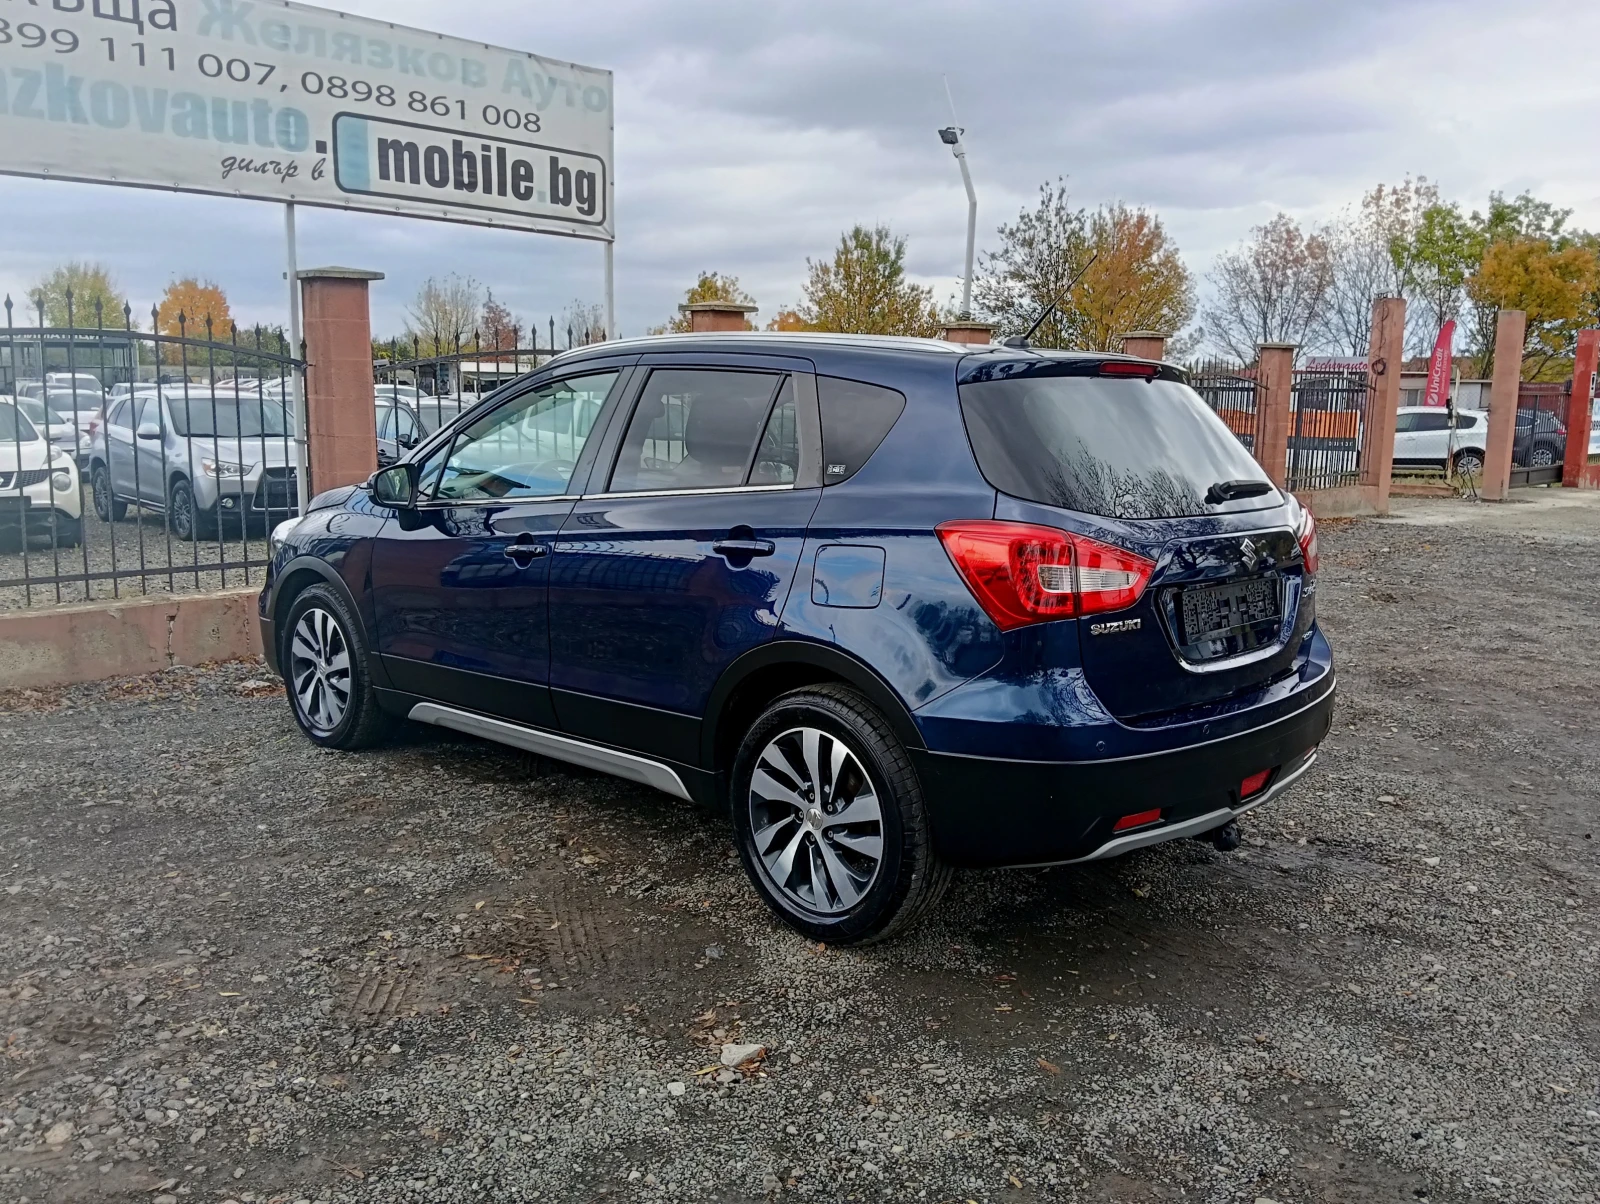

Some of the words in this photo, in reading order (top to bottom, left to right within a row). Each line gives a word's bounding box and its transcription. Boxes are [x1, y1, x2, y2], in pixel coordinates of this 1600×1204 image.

[99, 37, 176, 72] 111
[300, 71, 397, 108] 0898
[407, 90, 467, 121] 861
[482, 104, 542, 134] 008
[196, 0, 488, 89] Желязков
[502, 57, 609, 113] Ауто
[0, 61, 328, 155] zkovauto.
[220, 155, 300, 184] дилър
[1429, 347, 1444, 393] UniCredit
[1090, 618, 1141, 636] SUZUKI
